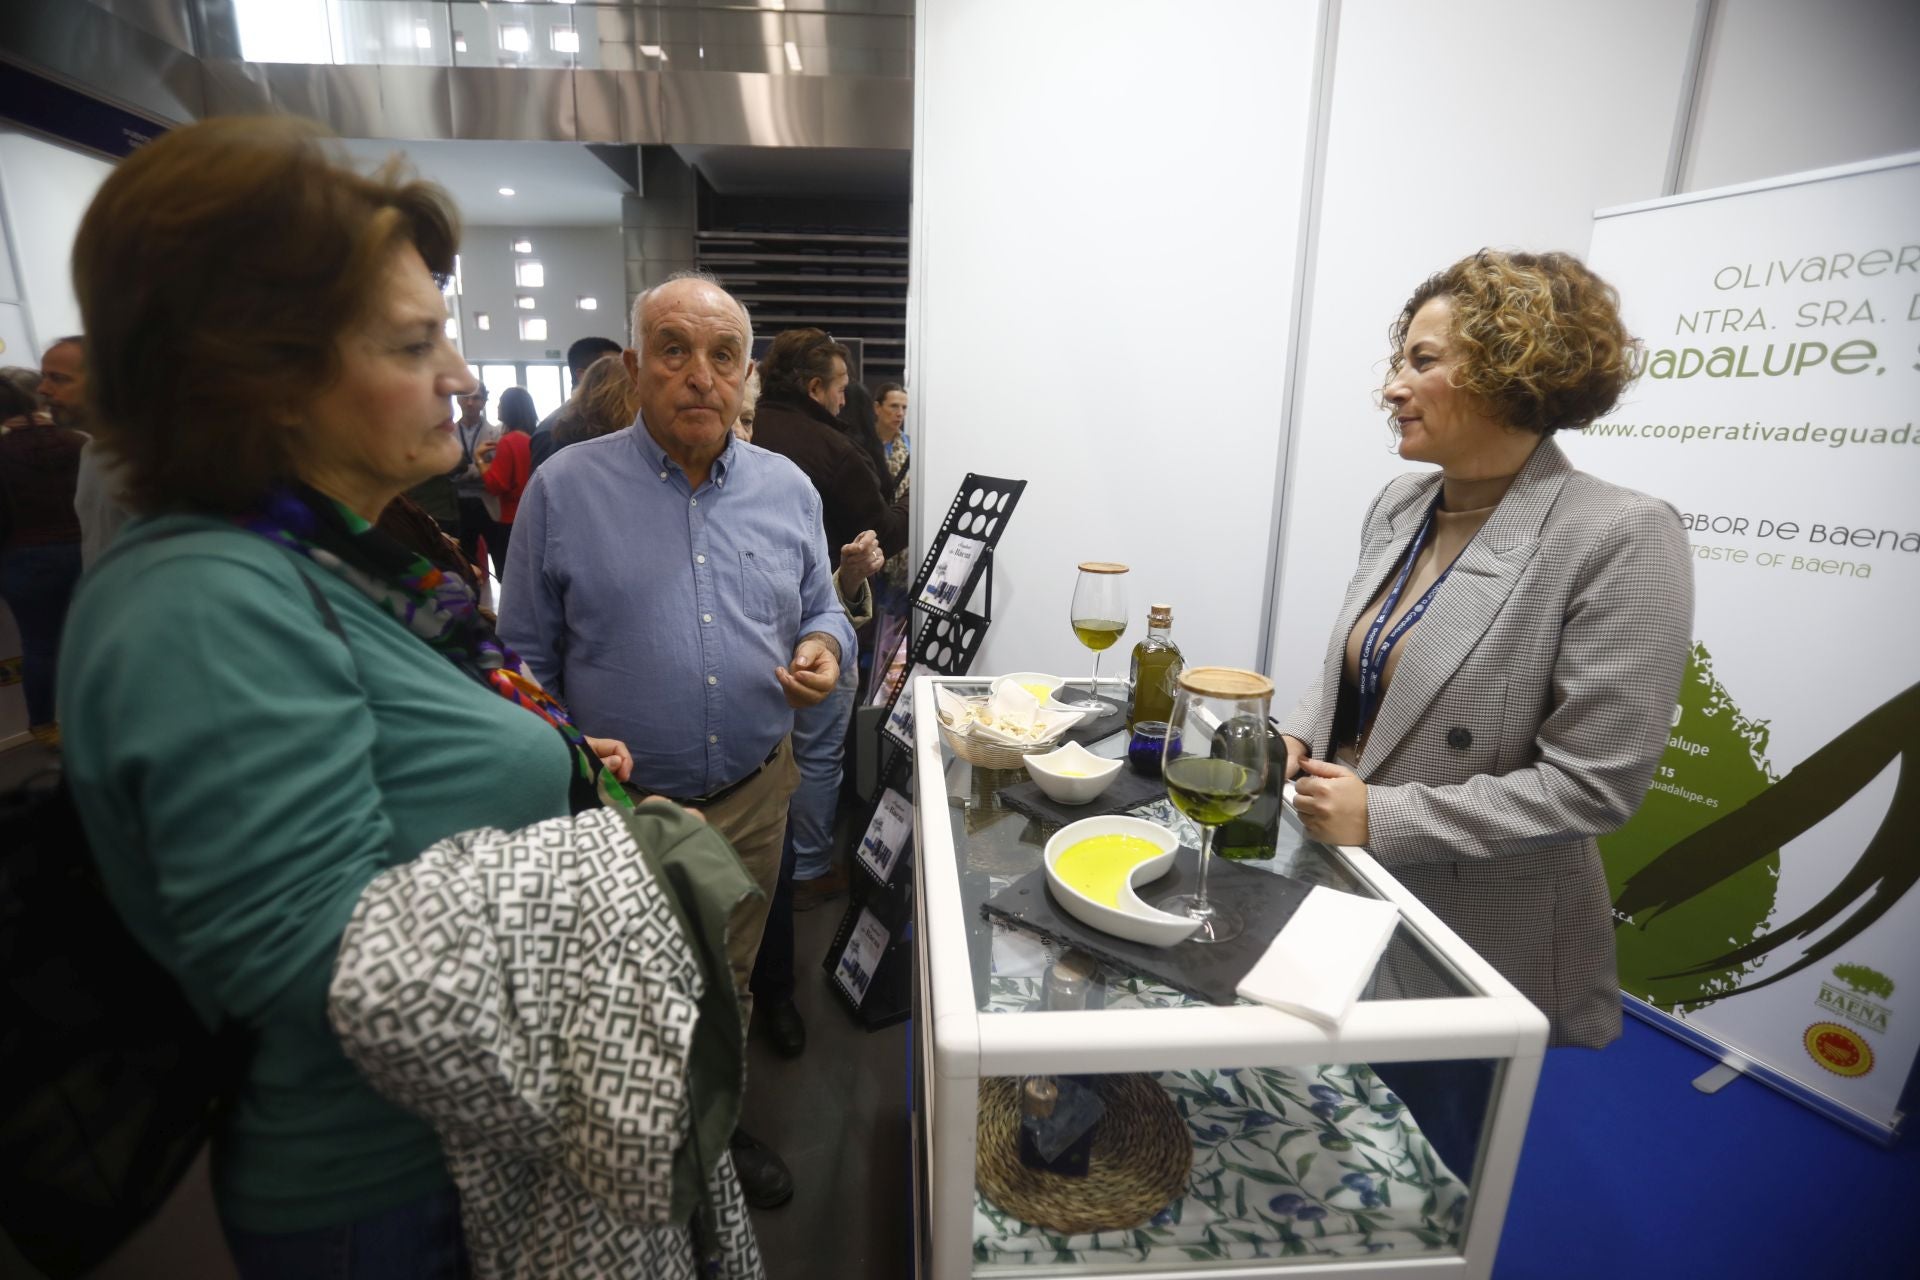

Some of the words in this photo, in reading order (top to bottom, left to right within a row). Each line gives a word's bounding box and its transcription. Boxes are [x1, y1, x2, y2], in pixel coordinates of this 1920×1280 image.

[1675, 307, 1776, 335] NTRA.
[1795, 298, 1886, 328] SRA.
[1680, 513, 1749, 536] aBOR
[1809, 524, 1920, 553] Baena
[1756, 552, 1785, 568] OF
[1791, 556, 1872, 579] Baena
[1666, 735, 1710, 757] alupe
[1611, 908, 1636, 926] S.C.A.
[1818, 987, 1888, 1031] BAENA
